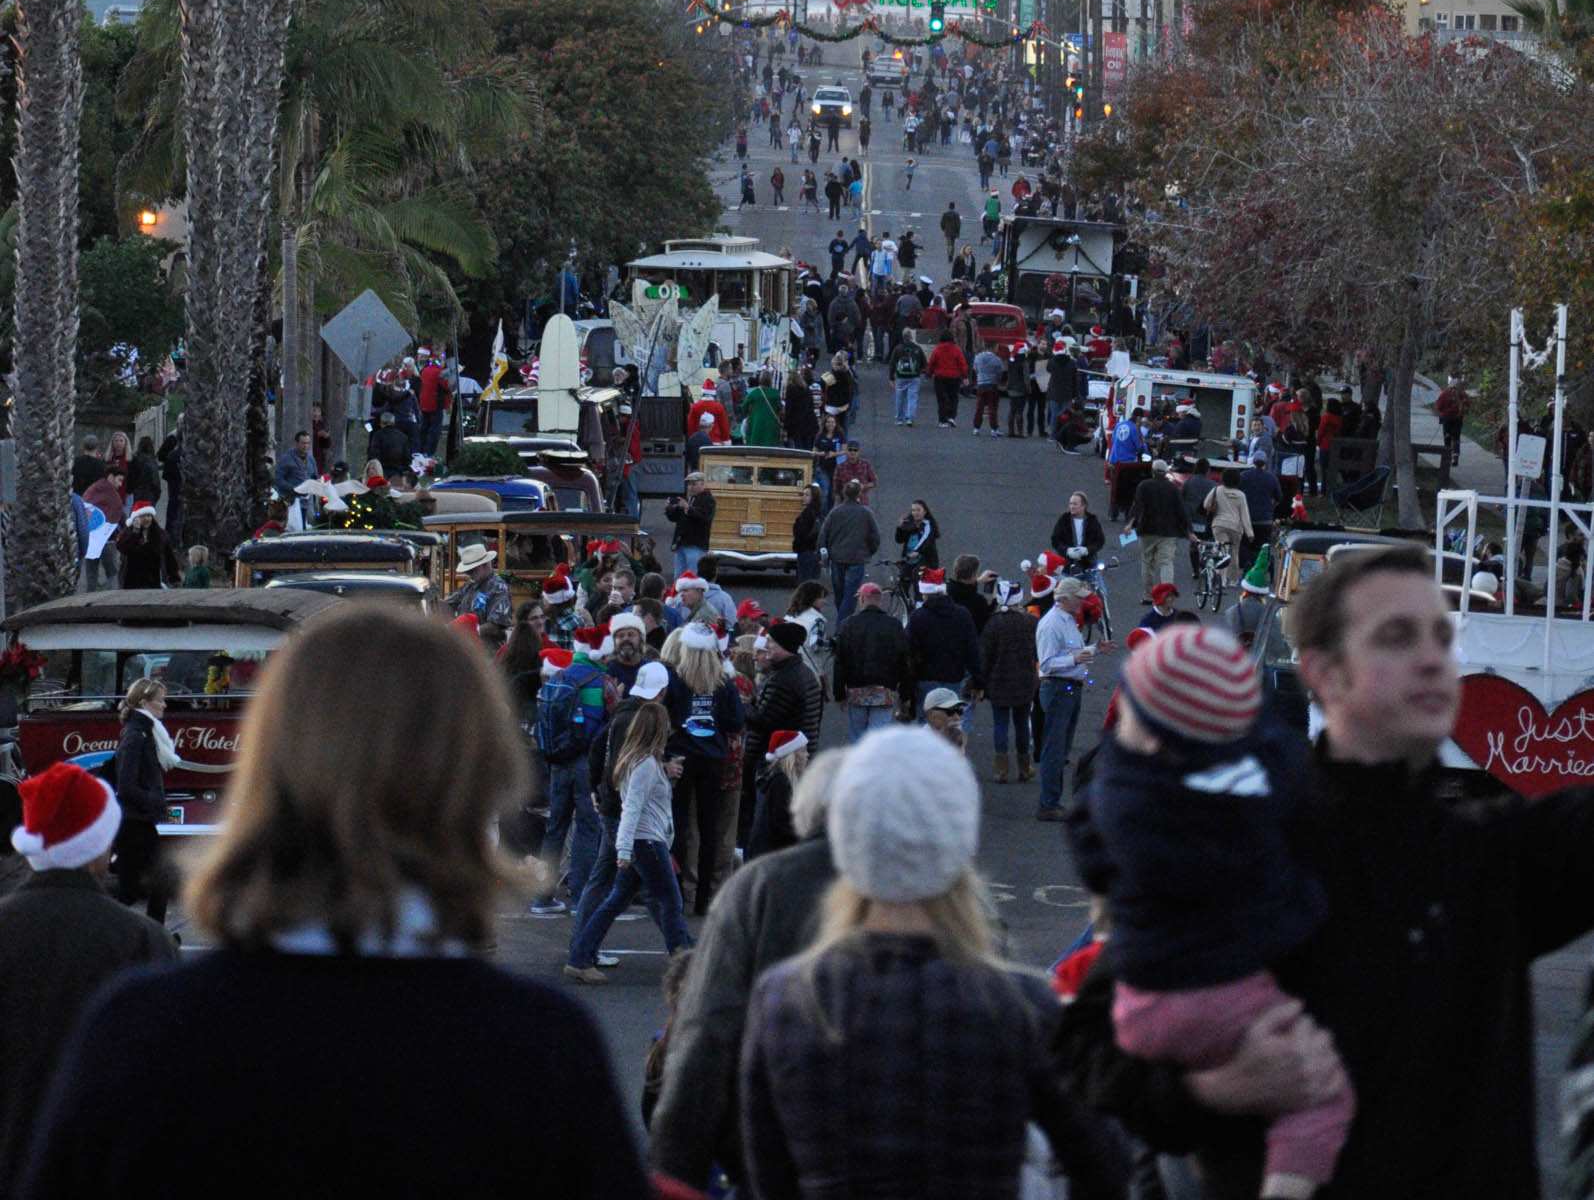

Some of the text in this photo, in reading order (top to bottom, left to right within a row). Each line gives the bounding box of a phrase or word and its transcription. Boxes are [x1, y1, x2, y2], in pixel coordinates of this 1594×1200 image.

[63, 732, 119, 753] Ocean
[186, 727, 240, 751] Hotel
[1514, 706, 1594, 753] Just
